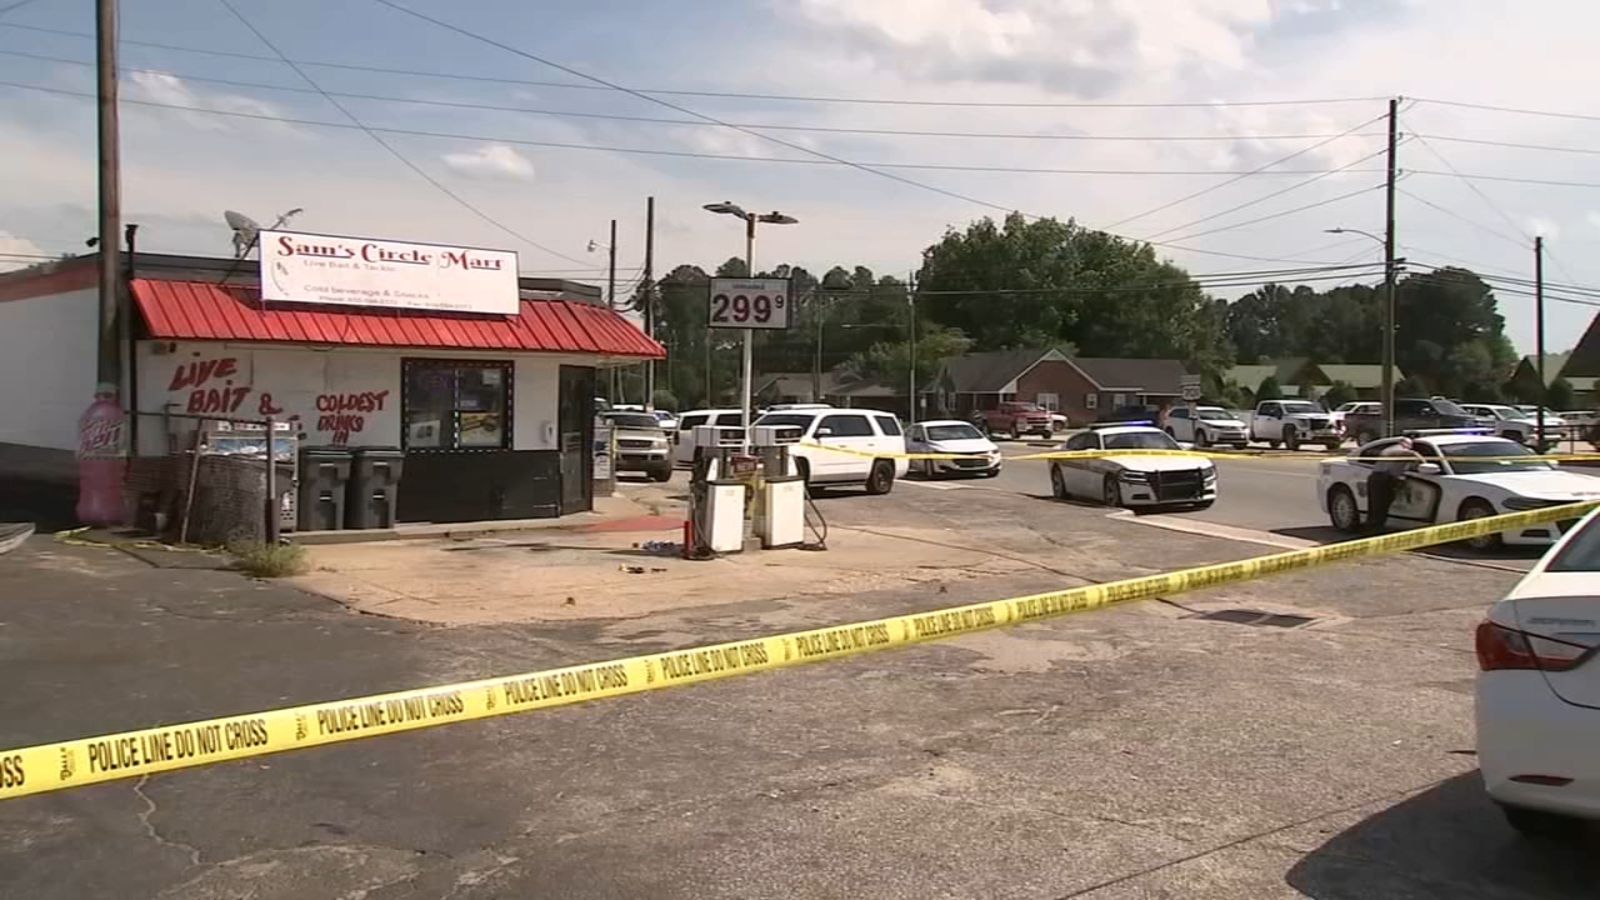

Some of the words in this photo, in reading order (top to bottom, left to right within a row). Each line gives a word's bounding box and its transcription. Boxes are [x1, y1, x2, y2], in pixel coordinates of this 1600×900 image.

[277, 236, 355, 257] Sam's
[361, 243, 432, 264] Circle
[440, 249, 505, 270] Mart
[304, 285, 329, 293] Cold
[712, 294, 771, 323] 299
[775, 295, 785, 310] 9
[258, 393, 283, 415] &
[316, 390, 389, 412] COLDEST
[660, 654, 692, 680] POLICE
[690, 651, 712, 675] LINE
[710, 649, 724, 671] DO
[722, 647, 741, 669] NOT
[740, 642, 769, 666] CROSS
[504, 678, 539, 705] POLICE
[540, 674, 562, 699] LINE
[561, 672, 577, 695] DO
[576, 669, 597, 692] NOT
[596, 664, 628, 690] CROSS
[317, 706, 360, 735] POLICE
[360, 702, 386, 728] LINE
[386, 699, 404, 723] DO
[404, 696, 426, 720] NOT
[428, 690, 464, 718] CROSS
[88, 738, 140, 773] POLICE
[141, 732, 174, 764] LINE
[175, 729, 194, 758] DO
[196, 725, 222, 755] NOT
[225, 719, 268, 750] CROSS
